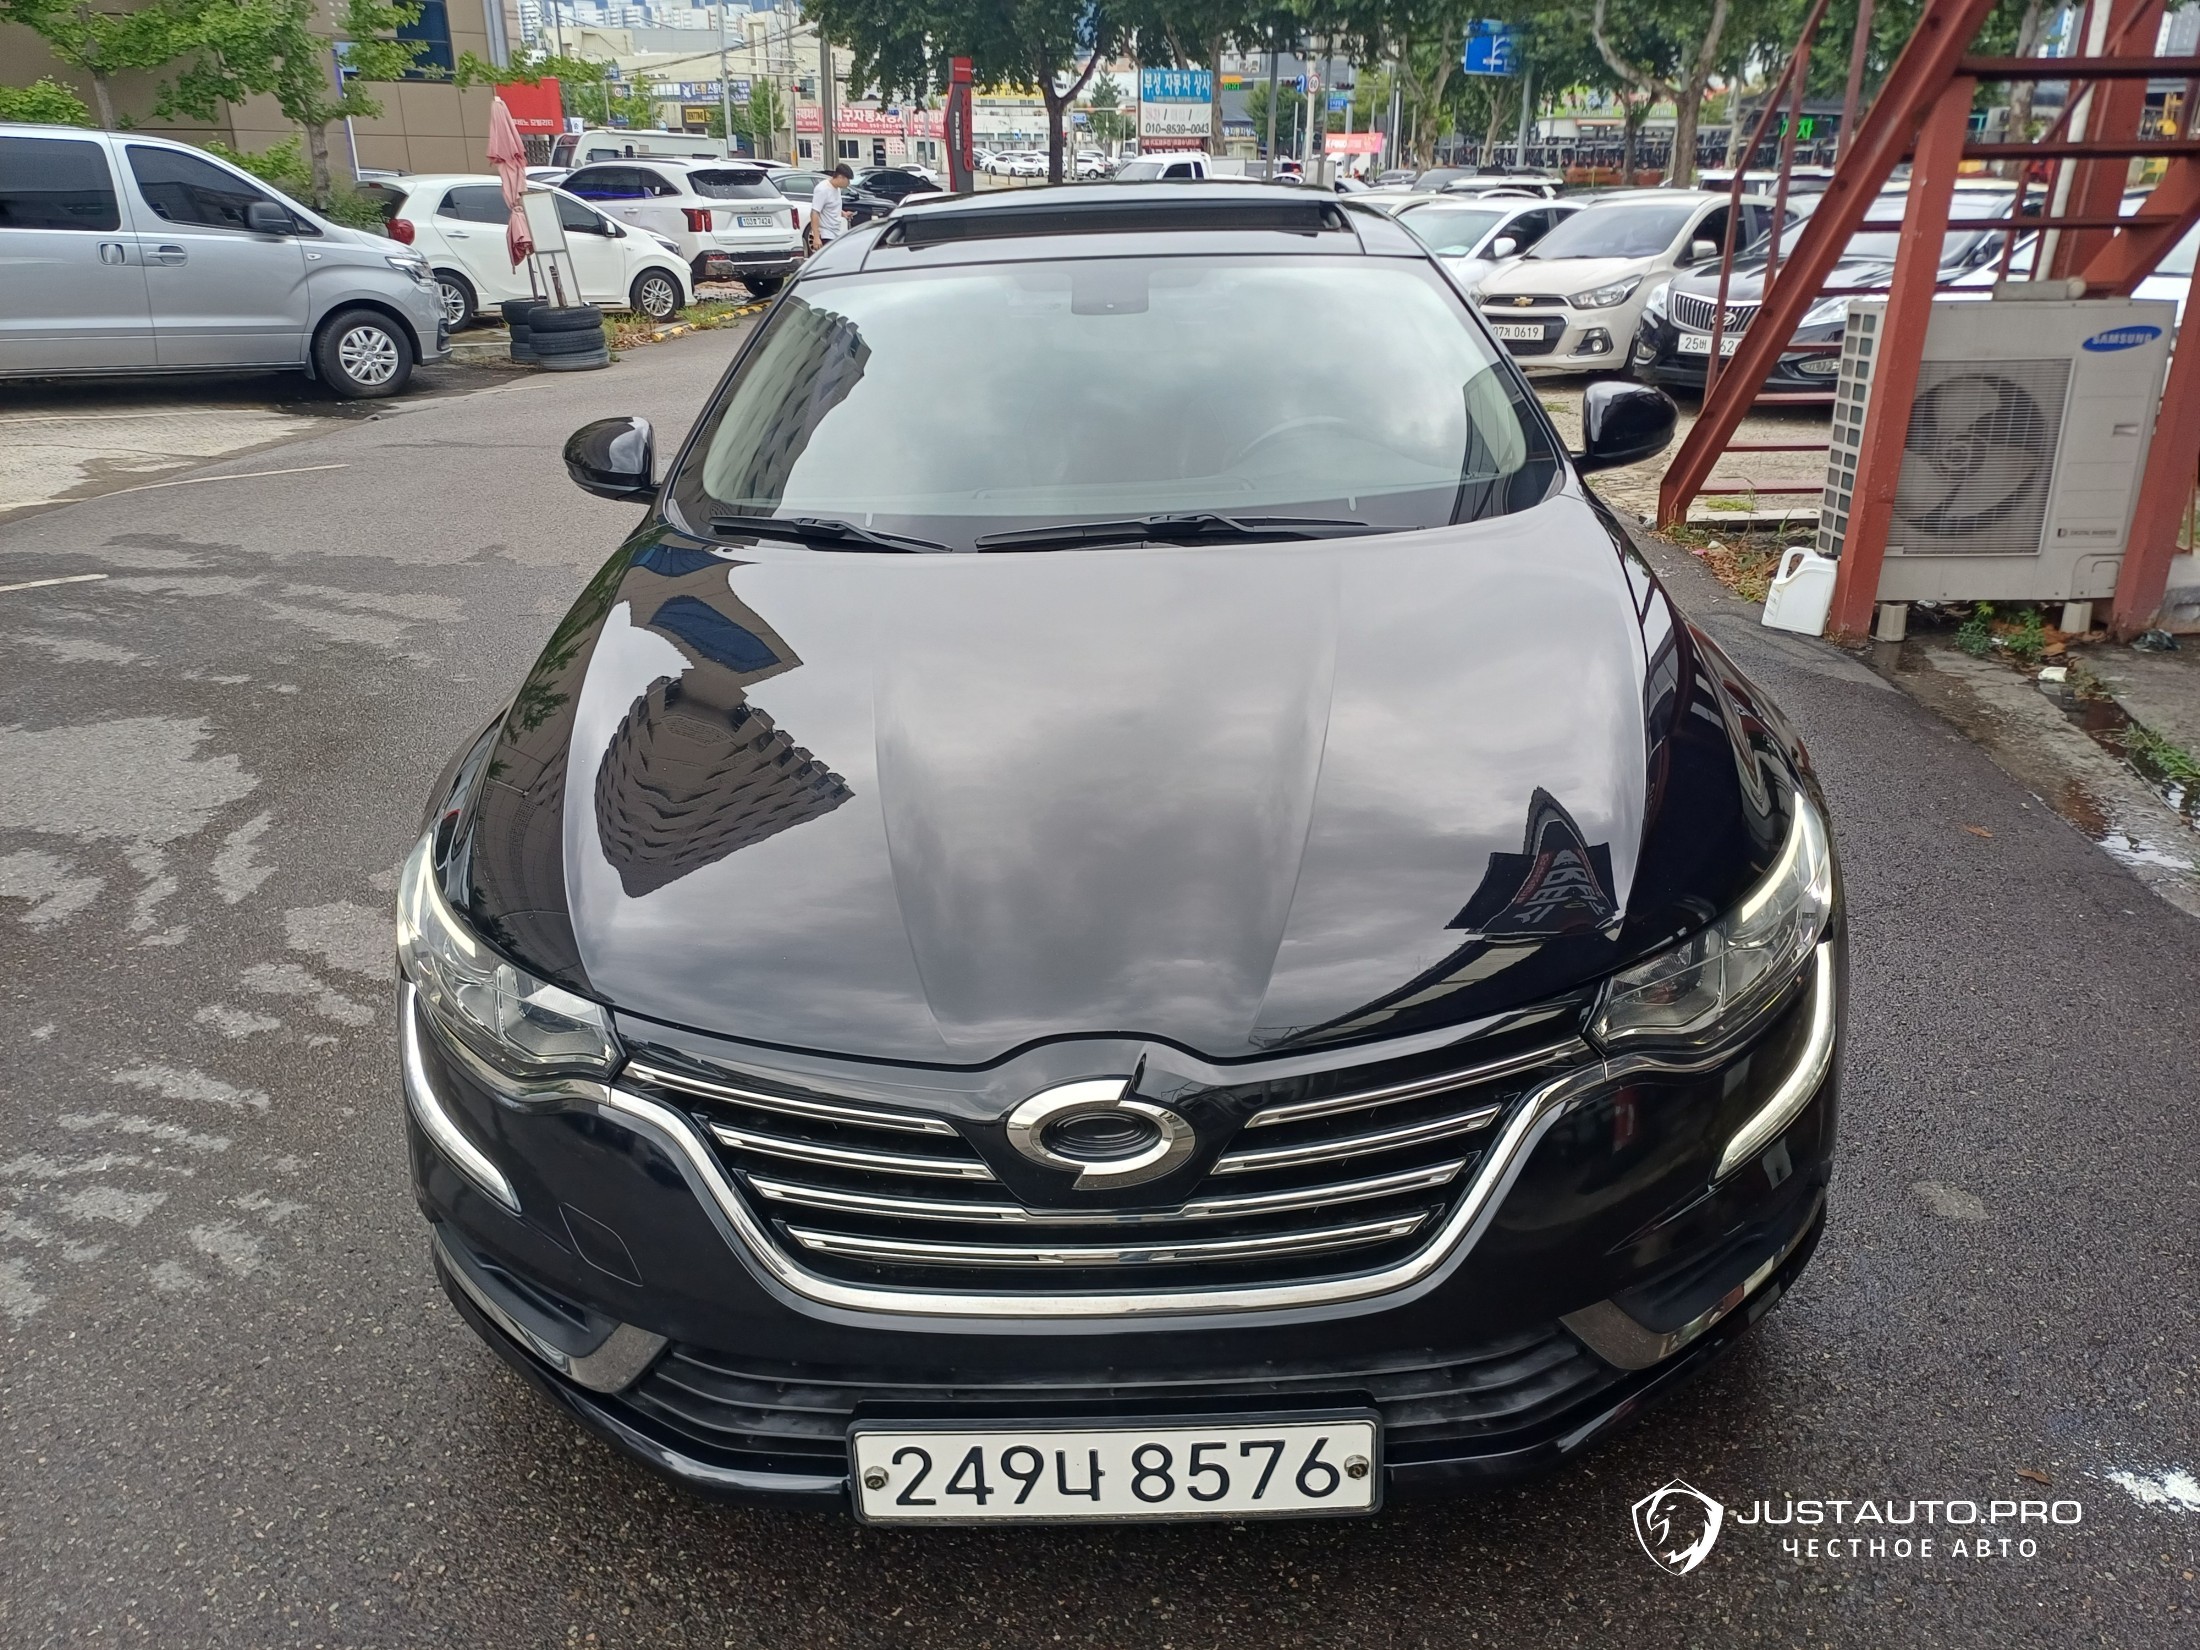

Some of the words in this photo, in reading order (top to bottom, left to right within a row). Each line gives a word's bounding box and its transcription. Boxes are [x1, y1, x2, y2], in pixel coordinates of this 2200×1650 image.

[1164, 73, 1191, 96] 자동차
[1193, 73, 1211, 96] 상사
[1145, 122, 1210, 134] 010-8539-0043
[1514, 326, 1539, 338] 0619
[2091, 332, 2153, 345] SAMSUNG
[892, 1445, 1106, 1507] 249나
[1131, 1437, 1341, 1504] 8576
